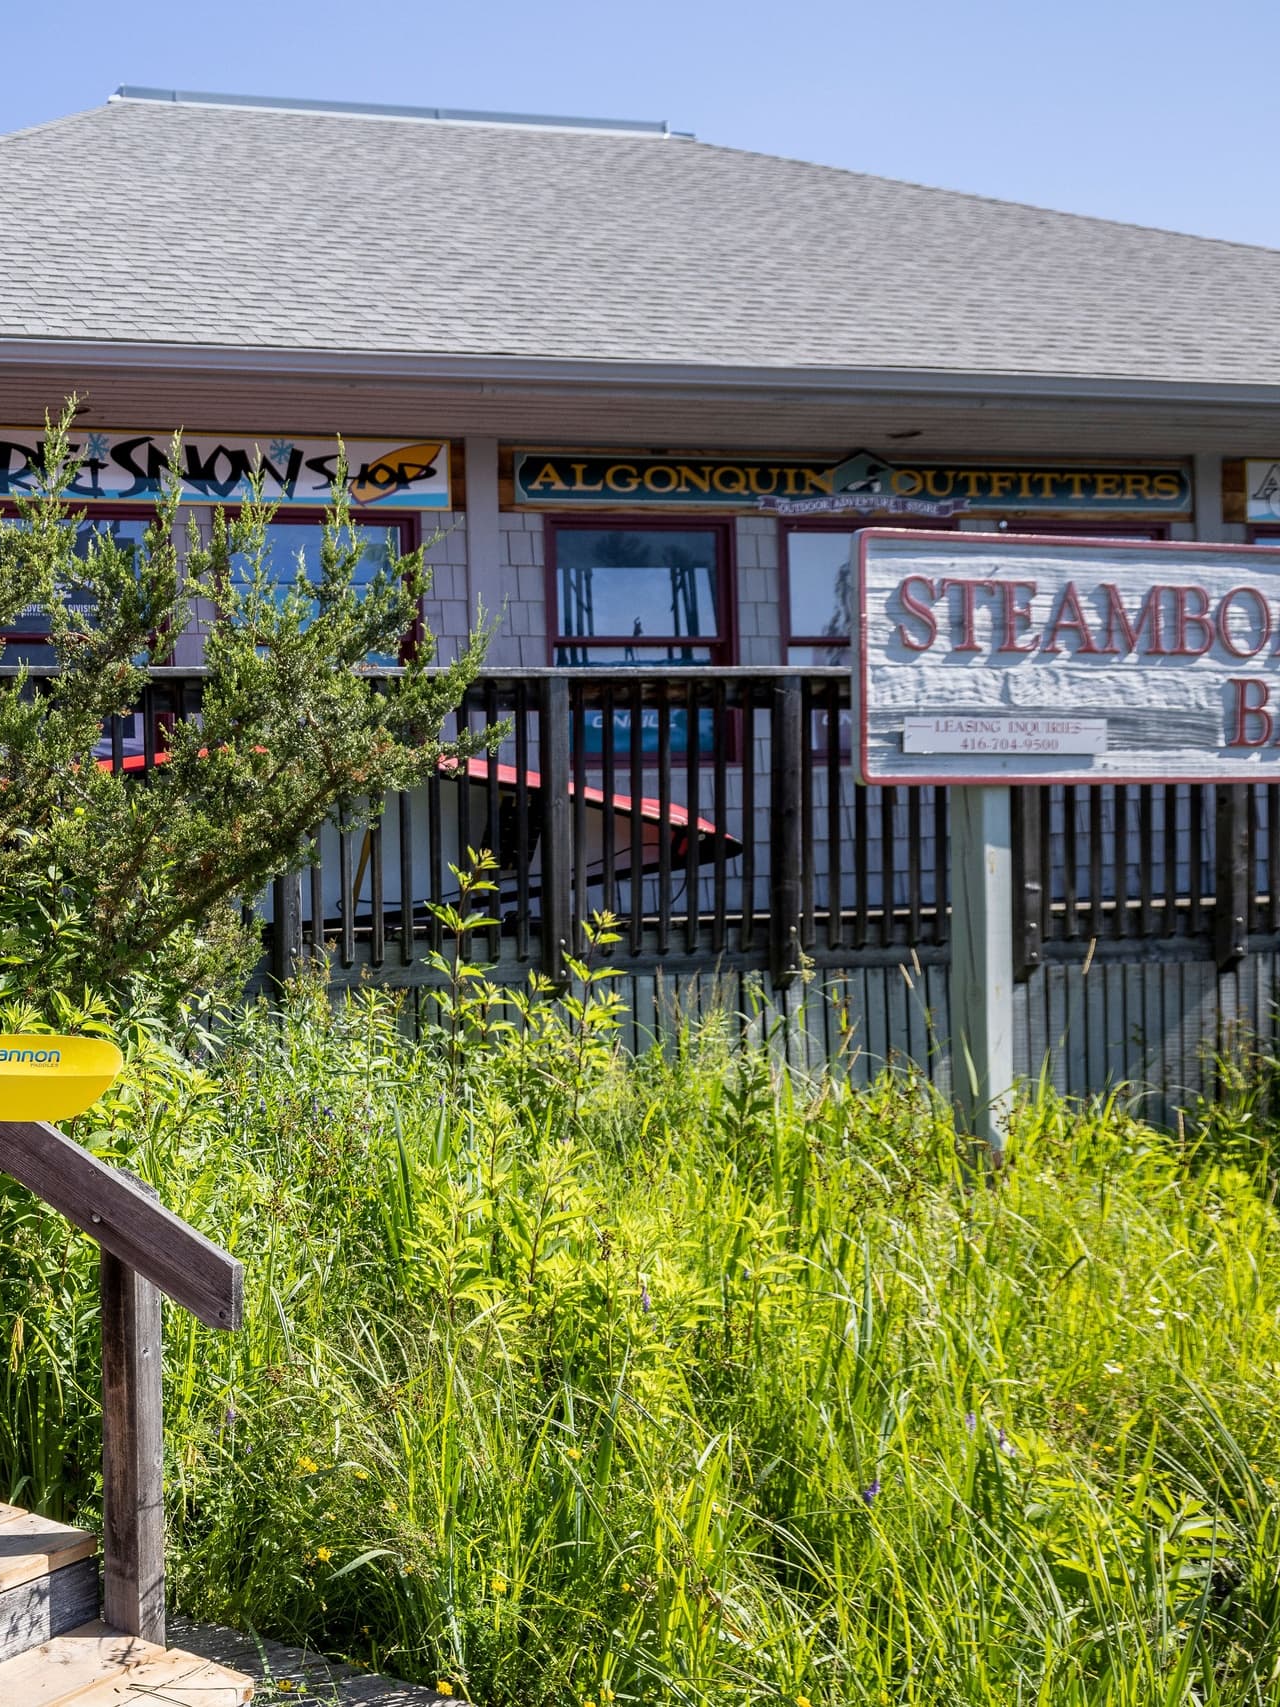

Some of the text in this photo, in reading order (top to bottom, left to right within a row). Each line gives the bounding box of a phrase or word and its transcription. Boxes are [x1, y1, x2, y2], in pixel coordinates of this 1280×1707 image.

[110, 436, 304, 500] SNOW
[306, 453, 438, 491] SHOP
[528, 461, 1181, 501] ALGONQUIN OUTFITTERS
[778, 499, 829, 514] OUTDOOR
[905, 502, 939, 514] STORE
[899, 575, 1280, 658] STEAMBO
[934, 719, 1082, 736] LEASING INQUIRIES
[1226, 677, 1280, 747] B
[959, 738, 1059, 751] 416-704-9500
